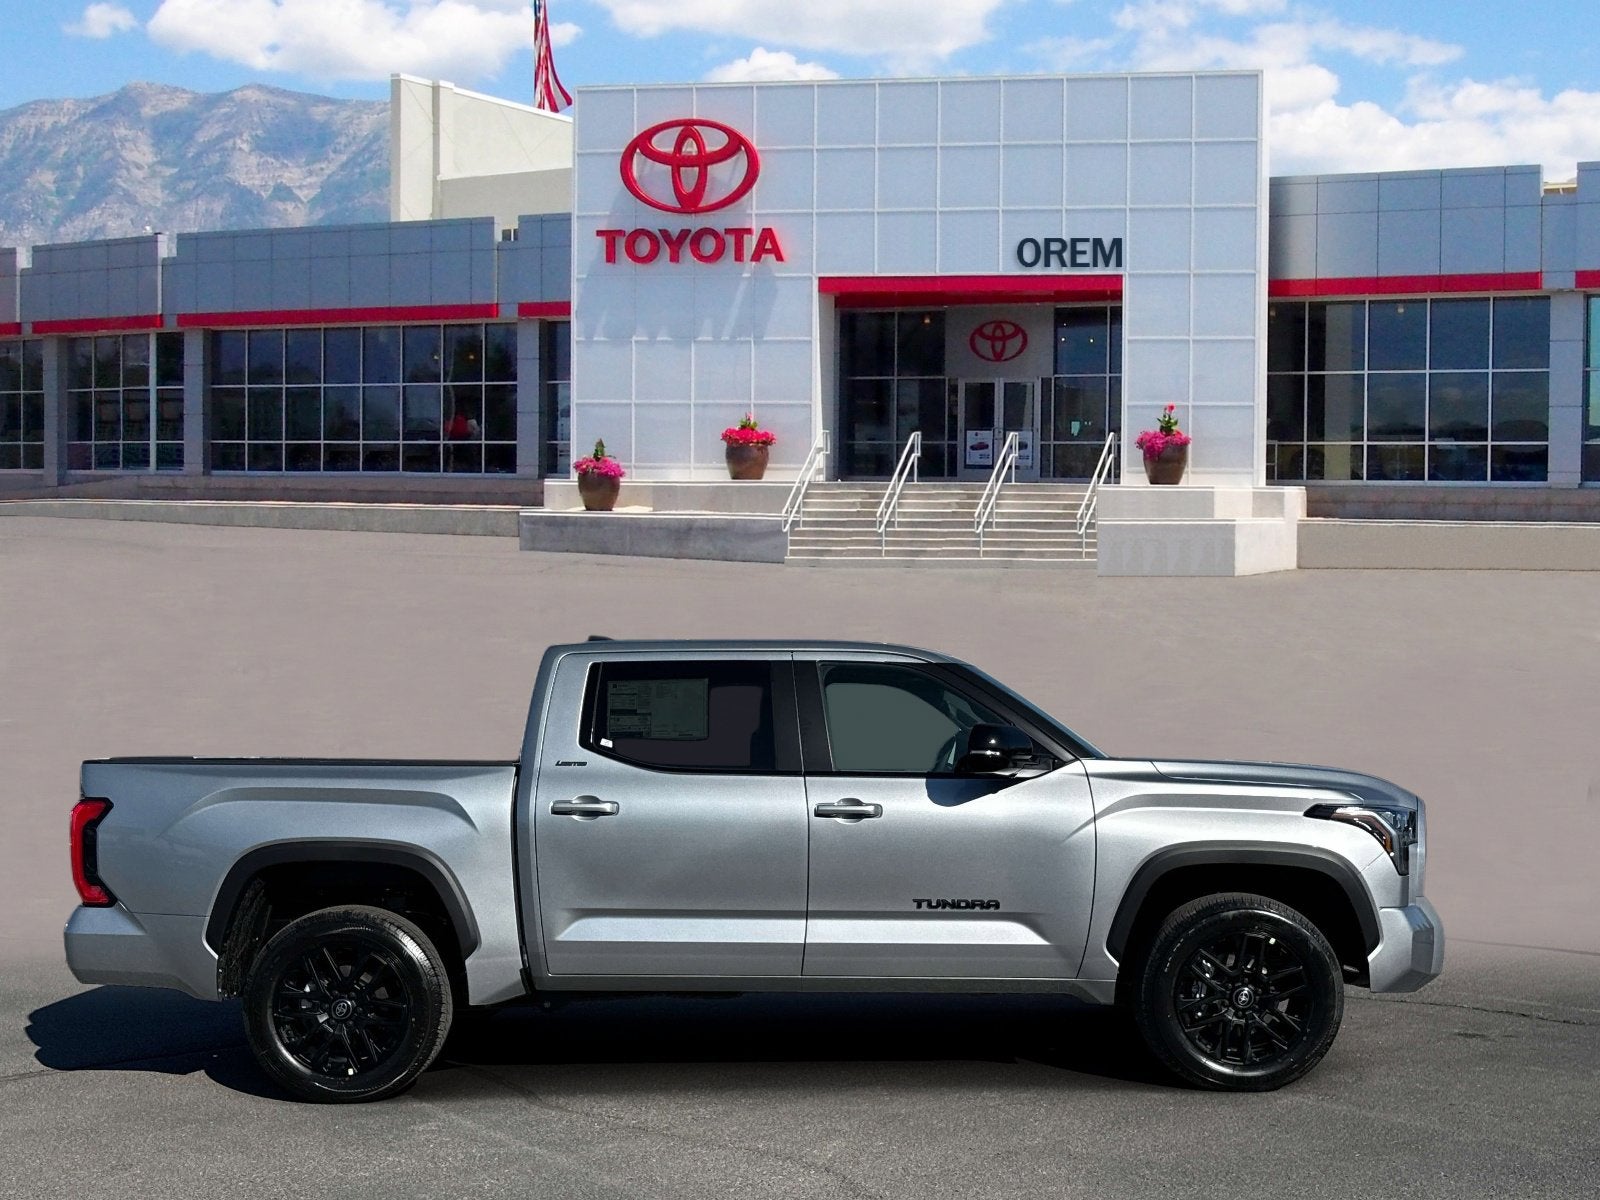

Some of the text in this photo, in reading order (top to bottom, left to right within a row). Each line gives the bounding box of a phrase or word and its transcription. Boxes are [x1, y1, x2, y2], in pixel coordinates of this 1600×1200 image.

[596, 227, 785, 264] TOYOTA
[1017, 237, 1123, 268] OREM
[912, 898, 1001, 911] TUNDRA
